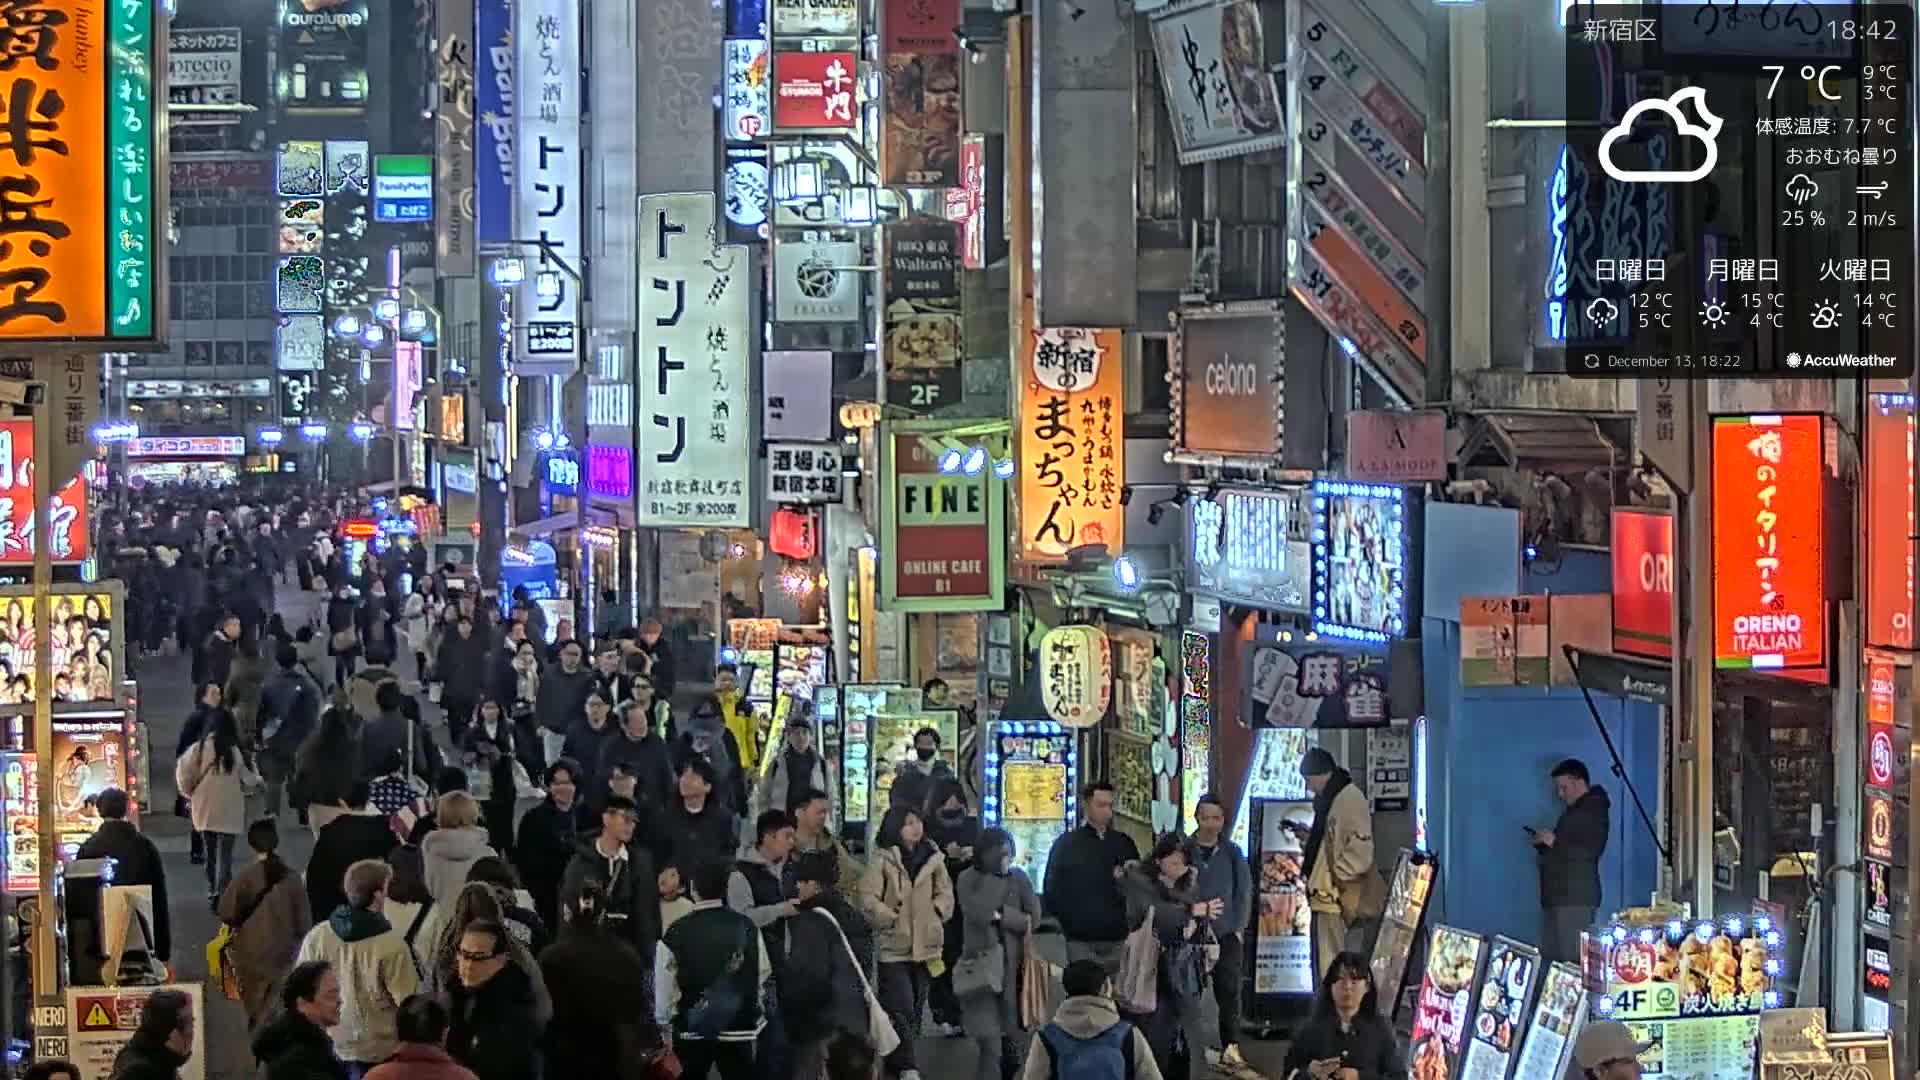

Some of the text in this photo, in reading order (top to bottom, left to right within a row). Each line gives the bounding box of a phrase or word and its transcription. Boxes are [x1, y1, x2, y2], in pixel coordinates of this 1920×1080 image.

[288, 13, 362, 25] auralume
[170, 36, 238, 49] ネットカフェ
[824, 59, 852, 121] 牛門
[400, 204, 427, 216] たばこ
[533, 136, 564, 312] トントン
[895, 255, 953, 272] Walton's
[654, 209, 696, 462] トントン
[1206, 353, 1257, 395] celona
[64, 354, 86, 445] 通り一番街
[910, 384, 941, 406] 2F
[1656, 376, 1675, 442] り一番街
[1034, 396, 1079, 545] まっちゃん
[772, 475, 837, 494] 新宿本店
[904, 485, 980, 514] FINE
[1748, 430, 1783, 604] 俺のイタリアン
[904, 560, 982, 575] ONLINE CAFE
[1640, 552, 1674, 593] OR
[935, 578, 952, 593] B1
[1734, 615, 1801, 633] ORENO
[1733, 634, 1802, 651] ITALIAN
[1616, 989, 1648, 1011] 4F
[34, 1006, 66, 1027] NERO
[37, 1035, 68, 1058] NERO
